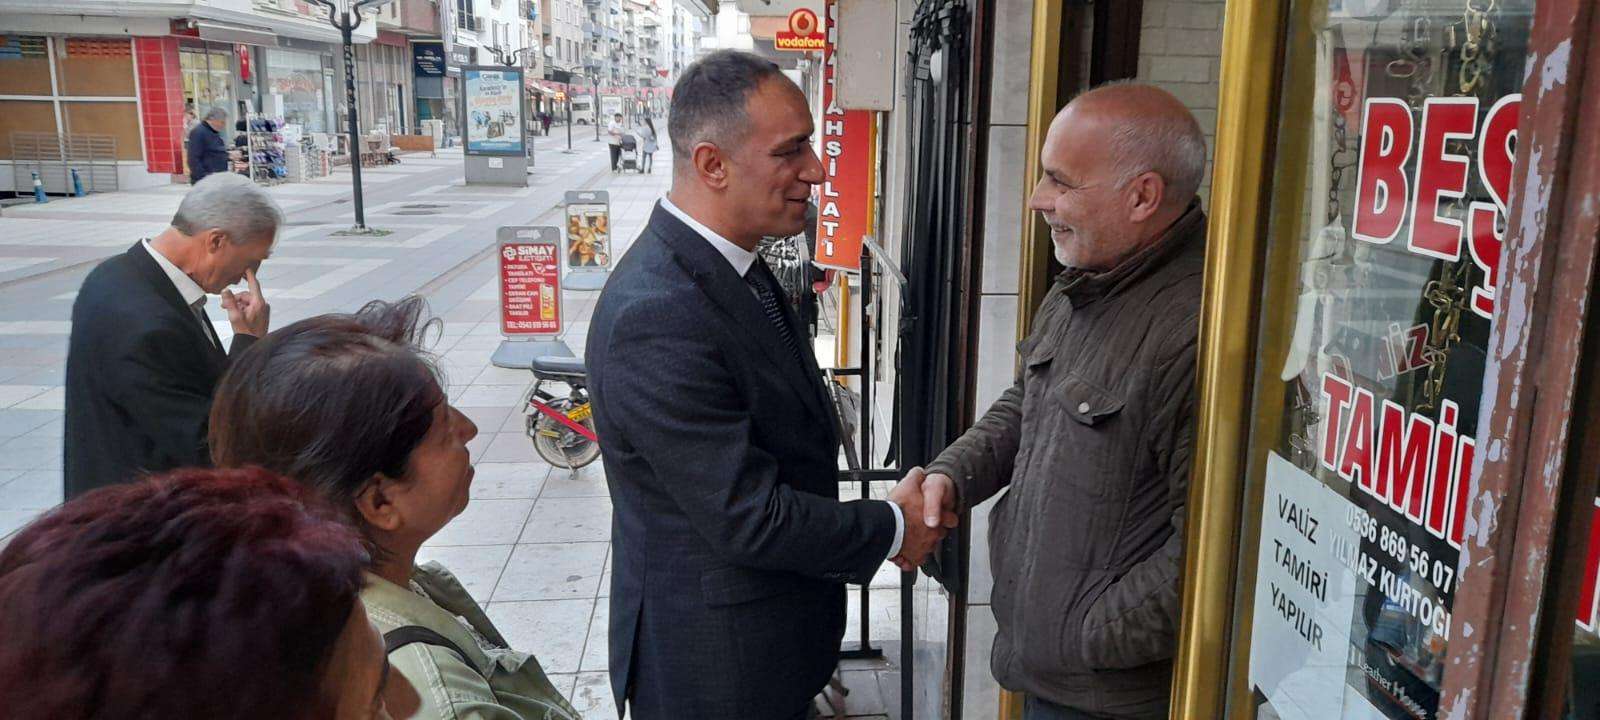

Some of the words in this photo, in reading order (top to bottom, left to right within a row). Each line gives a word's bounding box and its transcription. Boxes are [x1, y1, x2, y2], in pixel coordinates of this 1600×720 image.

[1278, 493, 1320, 545] VALİZ
[1346, 506, 1377, 544] 0536
[1380, 527, 1407, 563] 869
[1409, 546, 1429, 579] 56
[1432, 559, 1454, 595] 07
[1273, 539, 1329, 603] TAMİRİ
[1329, 528, 1378, 587] YILMAZ
[1270, 581, 1323, 653] YAPILIR
